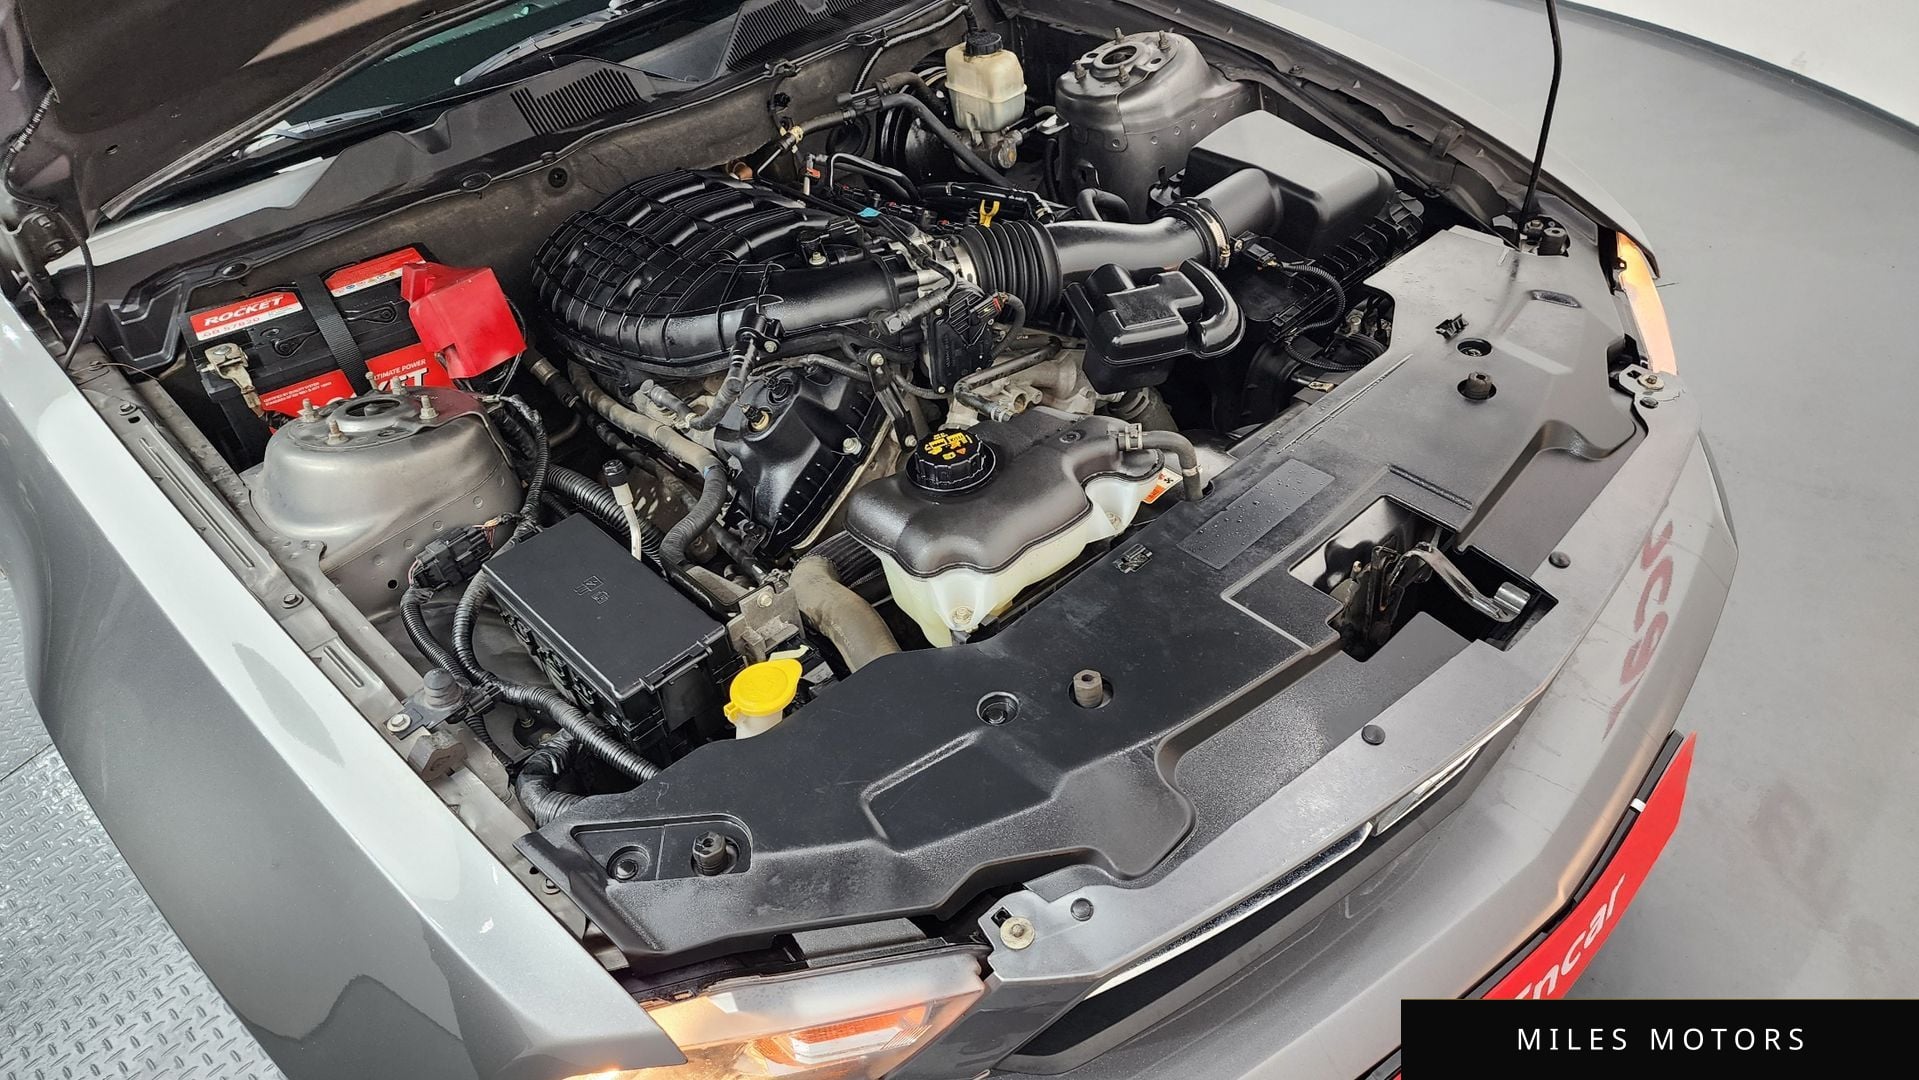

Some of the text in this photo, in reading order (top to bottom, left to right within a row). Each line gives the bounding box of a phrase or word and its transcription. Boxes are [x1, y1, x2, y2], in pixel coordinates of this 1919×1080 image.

[203, 296, 284, 326] ROCKET
[373, 358, 427, 381] LTIMATE POWER
